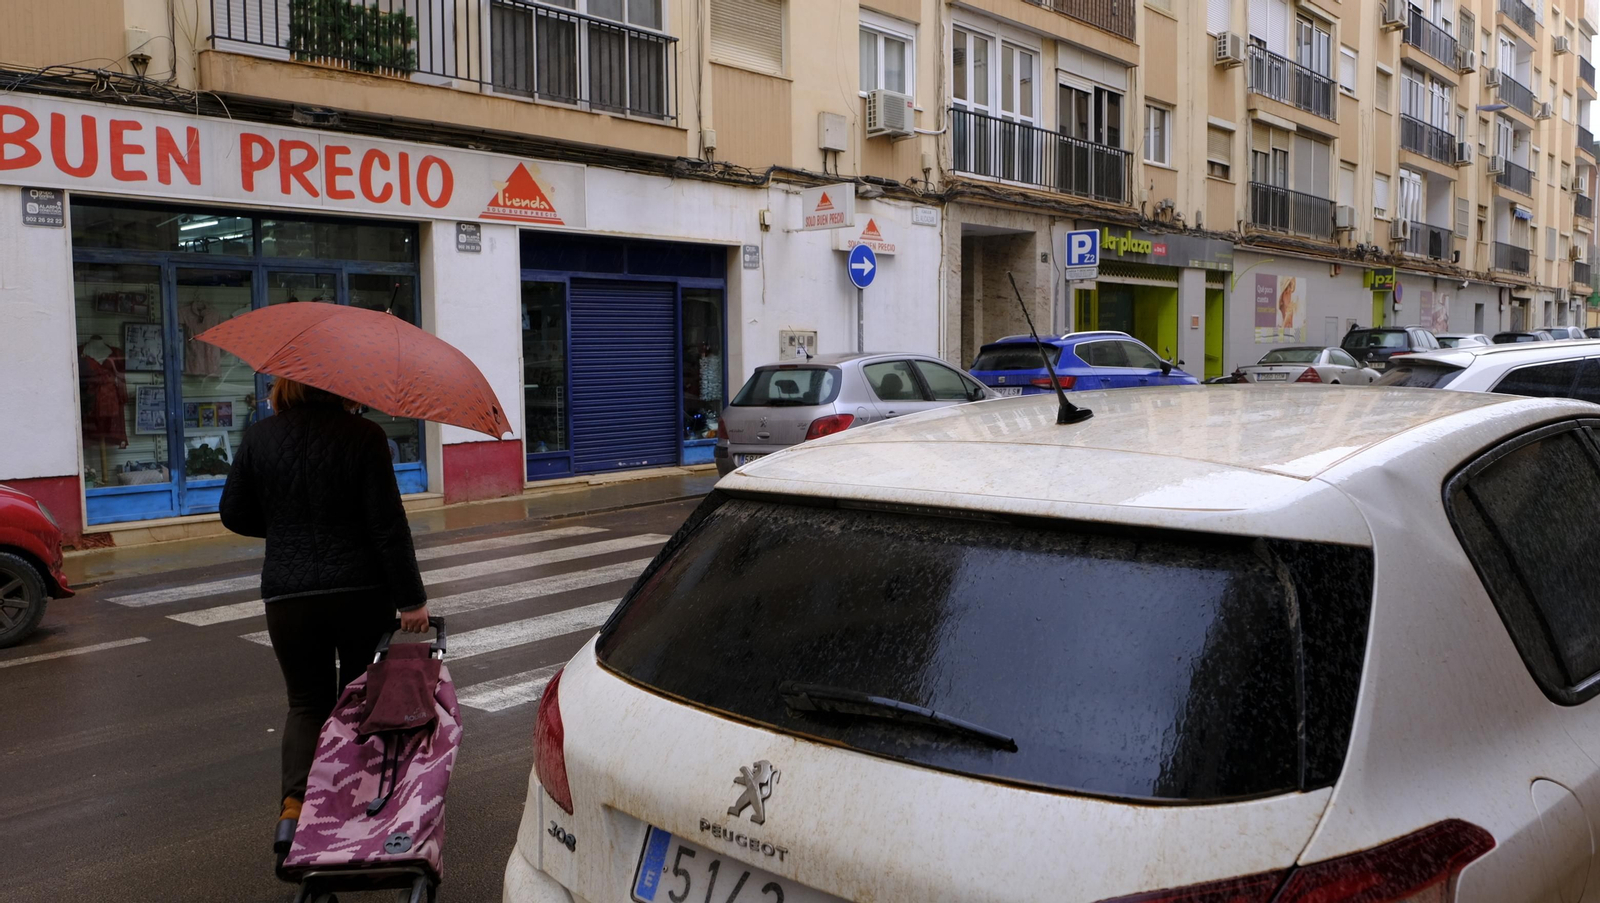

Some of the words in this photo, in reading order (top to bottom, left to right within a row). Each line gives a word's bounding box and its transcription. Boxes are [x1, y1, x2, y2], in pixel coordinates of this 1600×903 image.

[0, 104, 202, 187] BUEN
[239, 132, 455, 209] PRECIO
[492, 180, 550, 210] Tienda
[805, 215, 816, 227] SOLO
[817, 213, 828, 226] BUEN
[829, 211, 845, 224] PRECIO
[878, 242, 896, 252] PRECIO
[1071, 234, 1092, 264] P
[1102, 226, 1116, 250] la
[1117, 230, 1152, 256] plaza
[1084, 254, 1095, 263] Z2
[547, 819, 577, 852] 308
[699, 817, 789, 862] PEUGEOT
[644, 870, 656, 888] E
